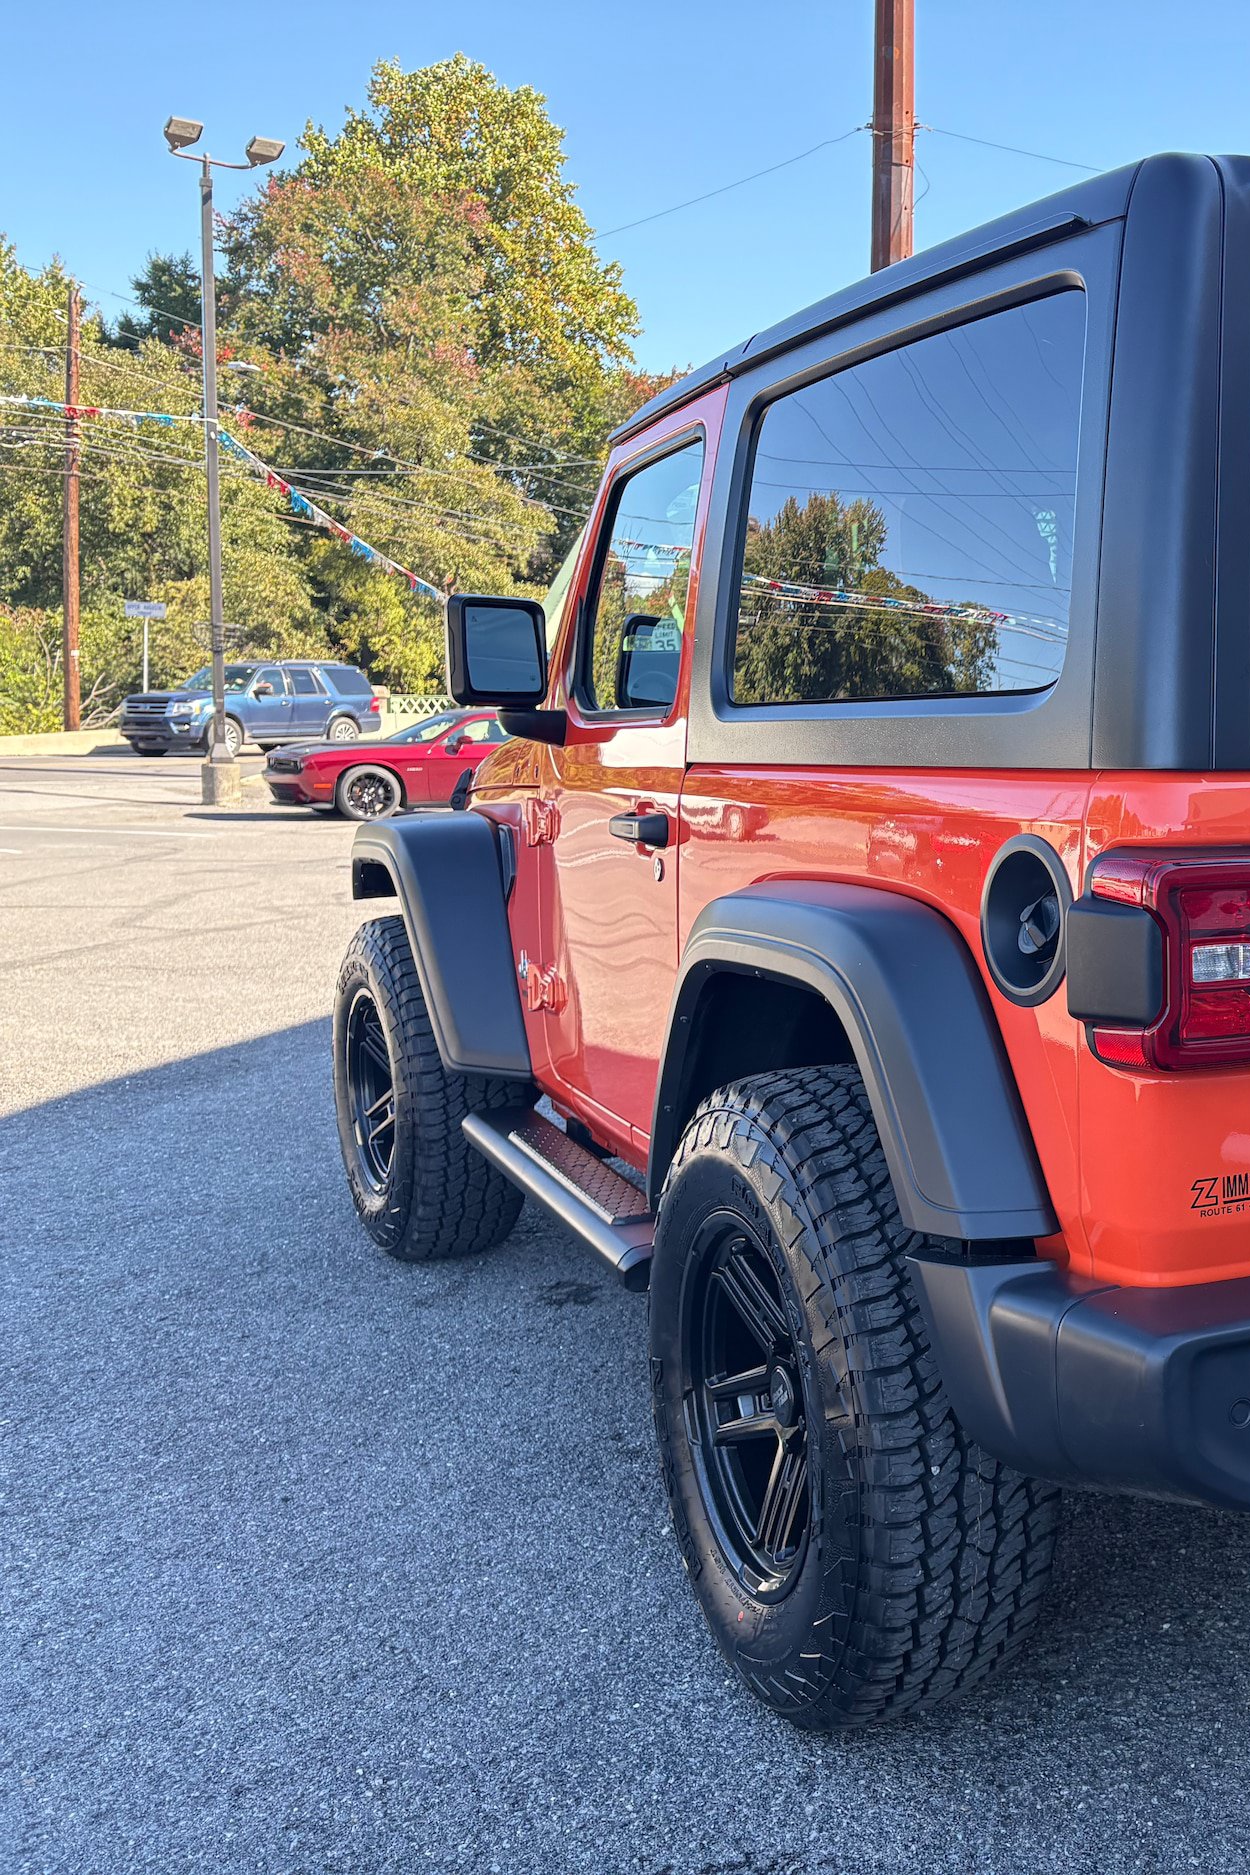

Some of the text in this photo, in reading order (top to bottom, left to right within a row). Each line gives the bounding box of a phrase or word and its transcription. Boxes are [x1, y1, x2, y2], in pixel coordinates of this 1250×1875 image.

[655, 631, 673, 639] LIMIT
[655, 639, 676, 651] 35
[1200, 1204, 1233, 1218] ROUTE
[1236, 1204, 1245, 1213] 61
